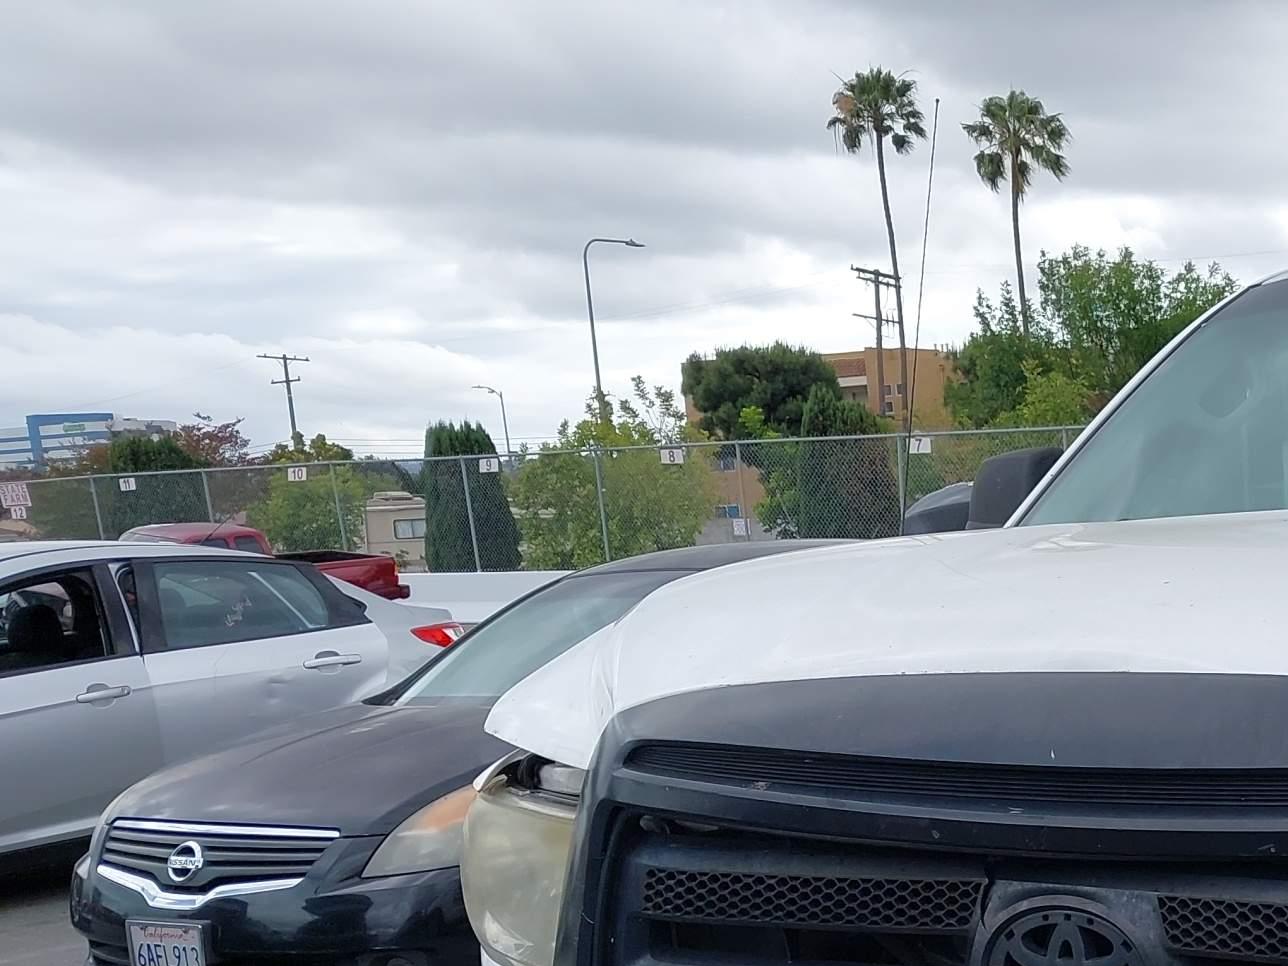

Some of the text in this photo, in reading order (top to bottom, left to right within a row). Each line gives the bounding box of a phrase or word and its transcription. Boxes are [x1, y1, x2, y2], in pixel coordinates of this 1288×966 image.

[914, 438, 923, 453] 7
[668, 450, 676, 463] 8
[485, 459, 492, 471] 9
[292, 468, 304, 480] 10
[0, 483, 27, 495] STATE
[123, 479, 131, 490] 11
[4, 493, 29, 504] FARM
[13, 507, 25, 519] 12
